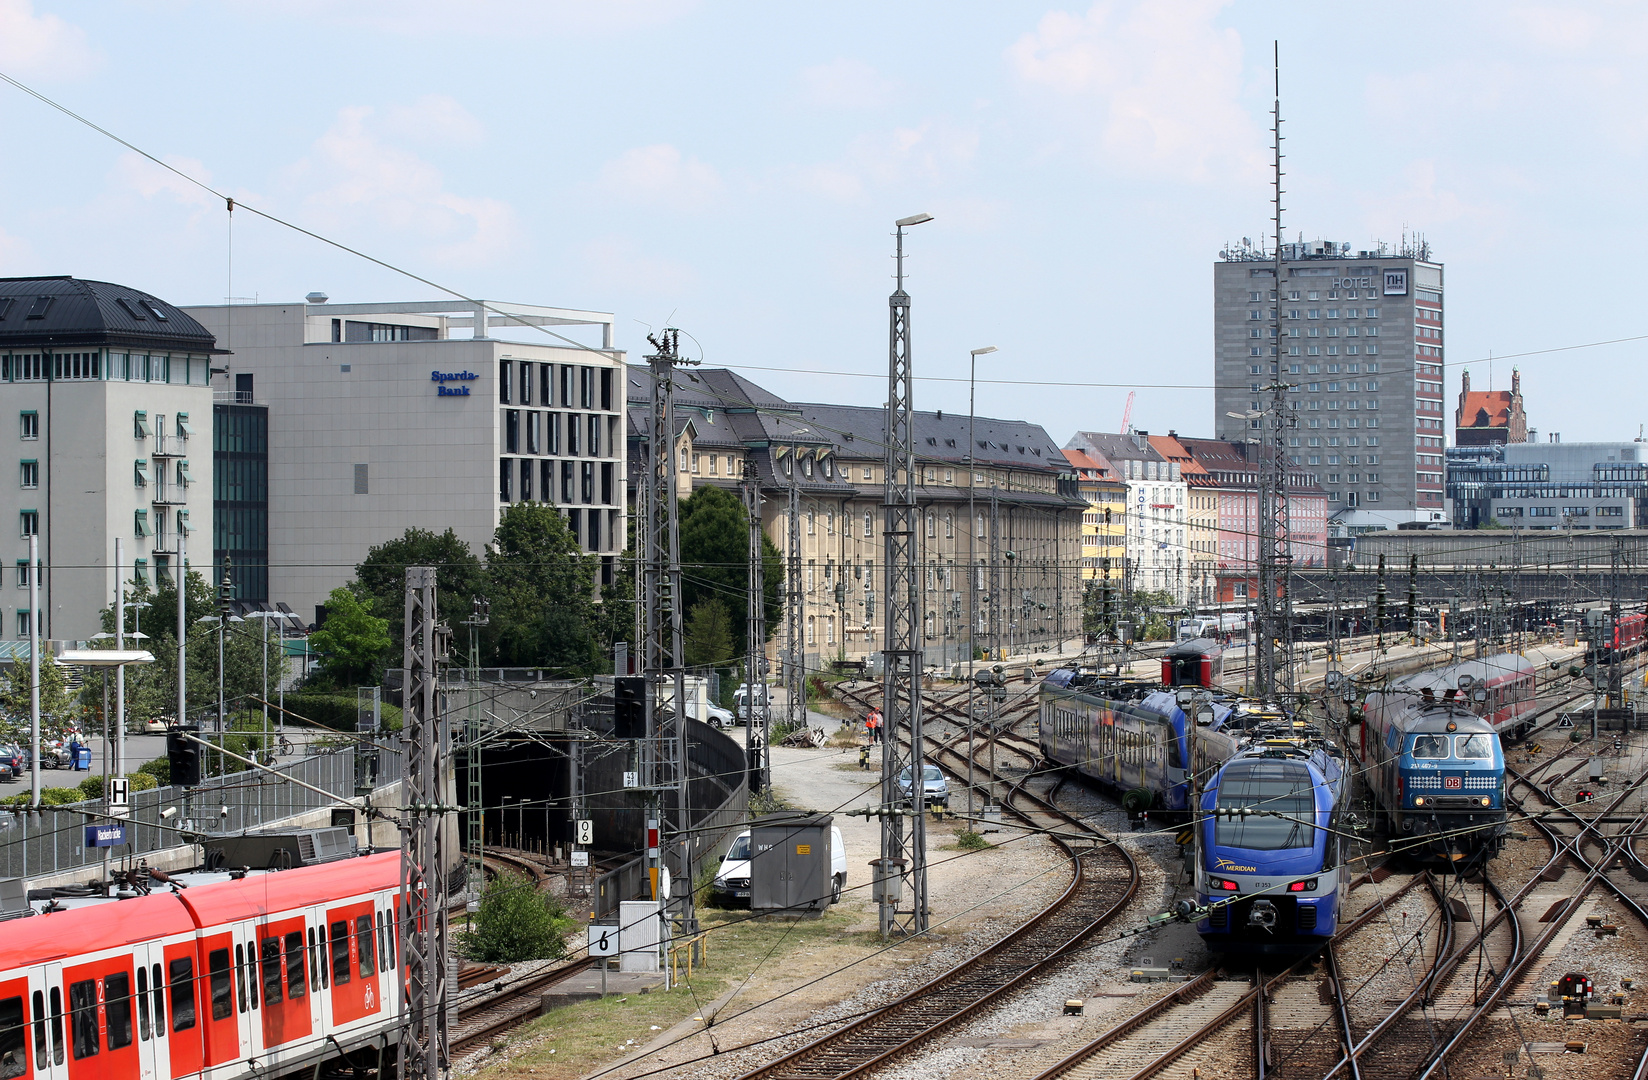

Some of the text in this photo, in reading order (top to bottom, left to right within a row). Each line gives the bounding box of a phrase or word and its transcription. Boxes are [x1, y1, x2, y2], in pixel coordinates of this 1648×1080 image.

[1332, 277, 1376, 289] HOTEL
[431, 370, 480, 384] Sparda-
[437, 385, 470, 396] Bank
[1563, 717, 1568, 726] 3
[1446, 779, 1460, 787] DB
[112, 781, 127, 803] H
[581, 821, 589, 831] 0
[581, 832, 589, 842] 6
[599, 930, 609, 951] 6
[98, 981, 104, 1002] 2
